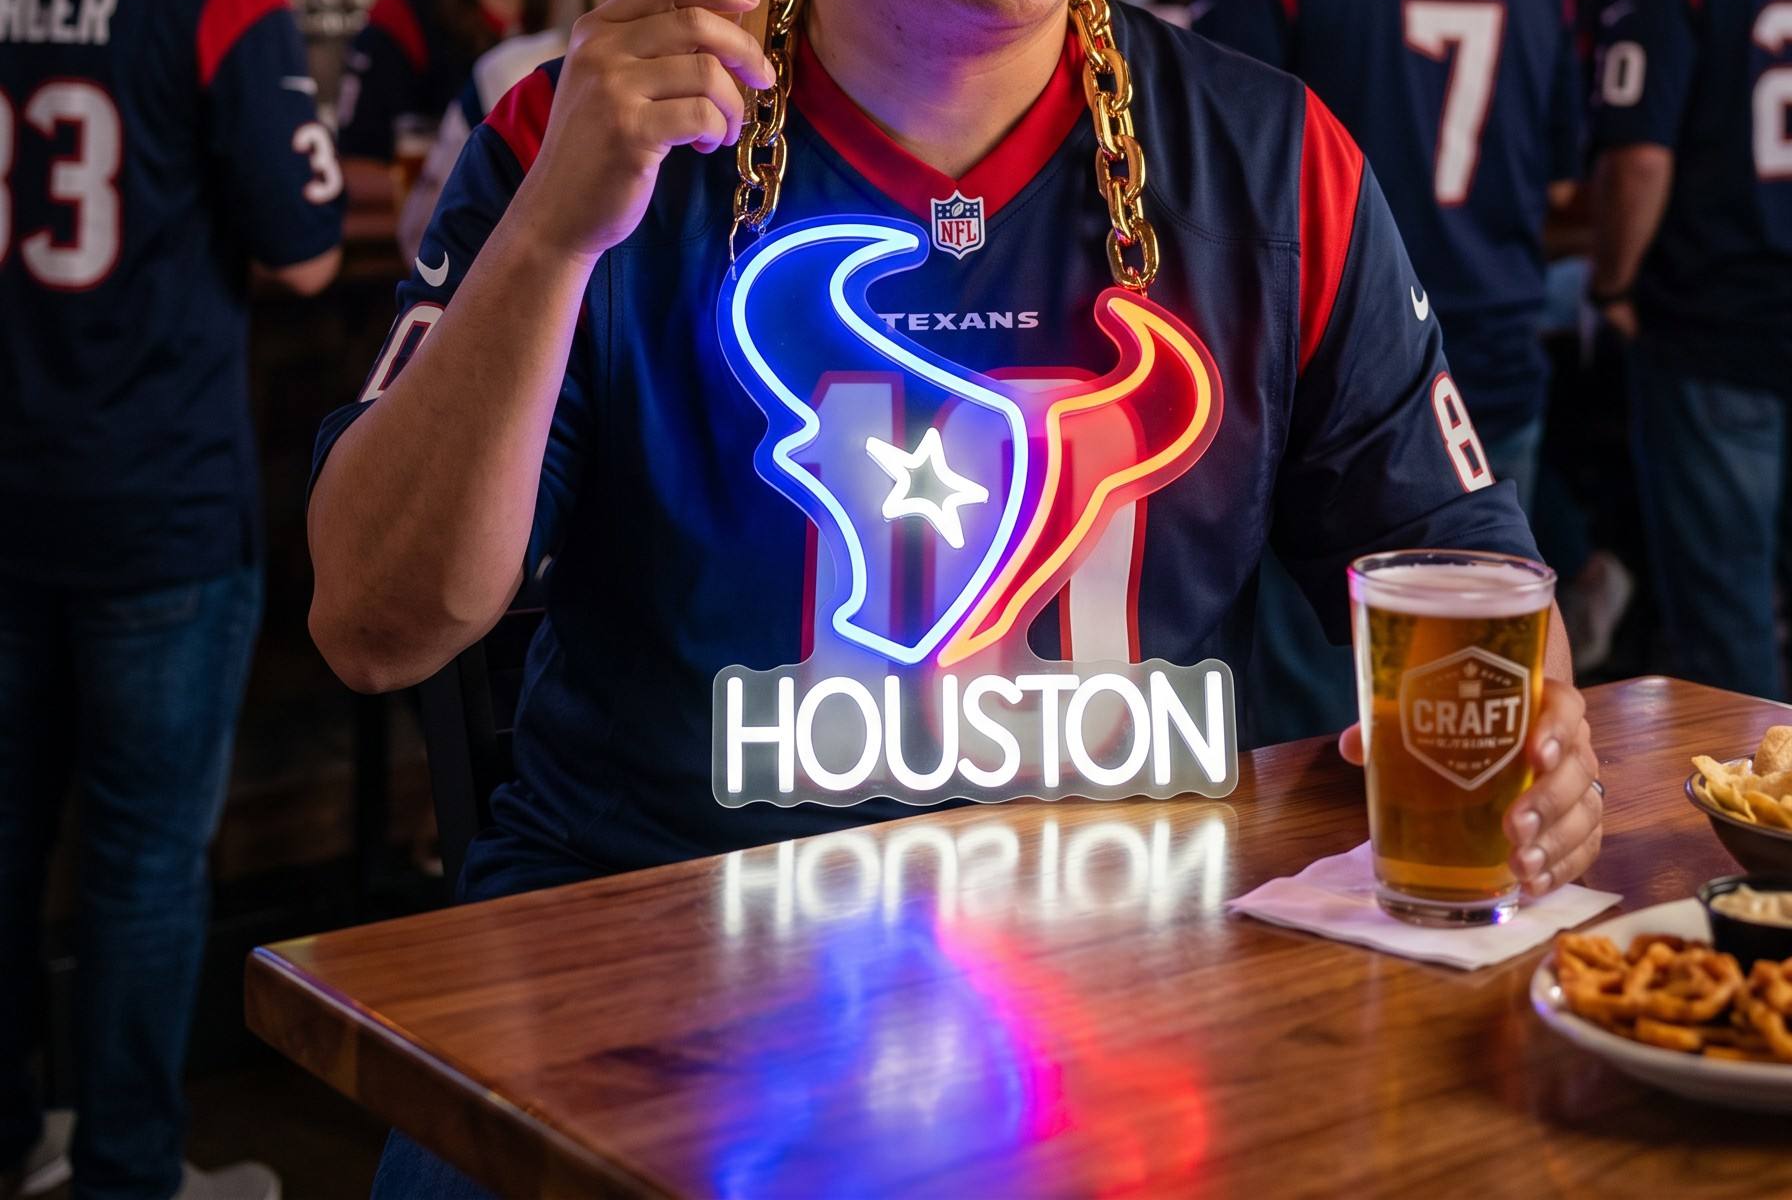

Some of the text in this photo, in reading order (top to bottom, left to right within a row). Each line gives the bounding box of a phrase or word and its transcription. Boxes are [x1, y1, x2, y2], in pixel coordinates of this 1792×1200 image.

[293, 122, 344, 204] 3
[940, 220, 977, 246] NFL
[877, 311, 1039, 332] TEXANS
[1431, 370, 1496, 494] 8
[726, 670, 1228, 792] HOUSTON
[1412, 696, 1521, 735] CRAFT
